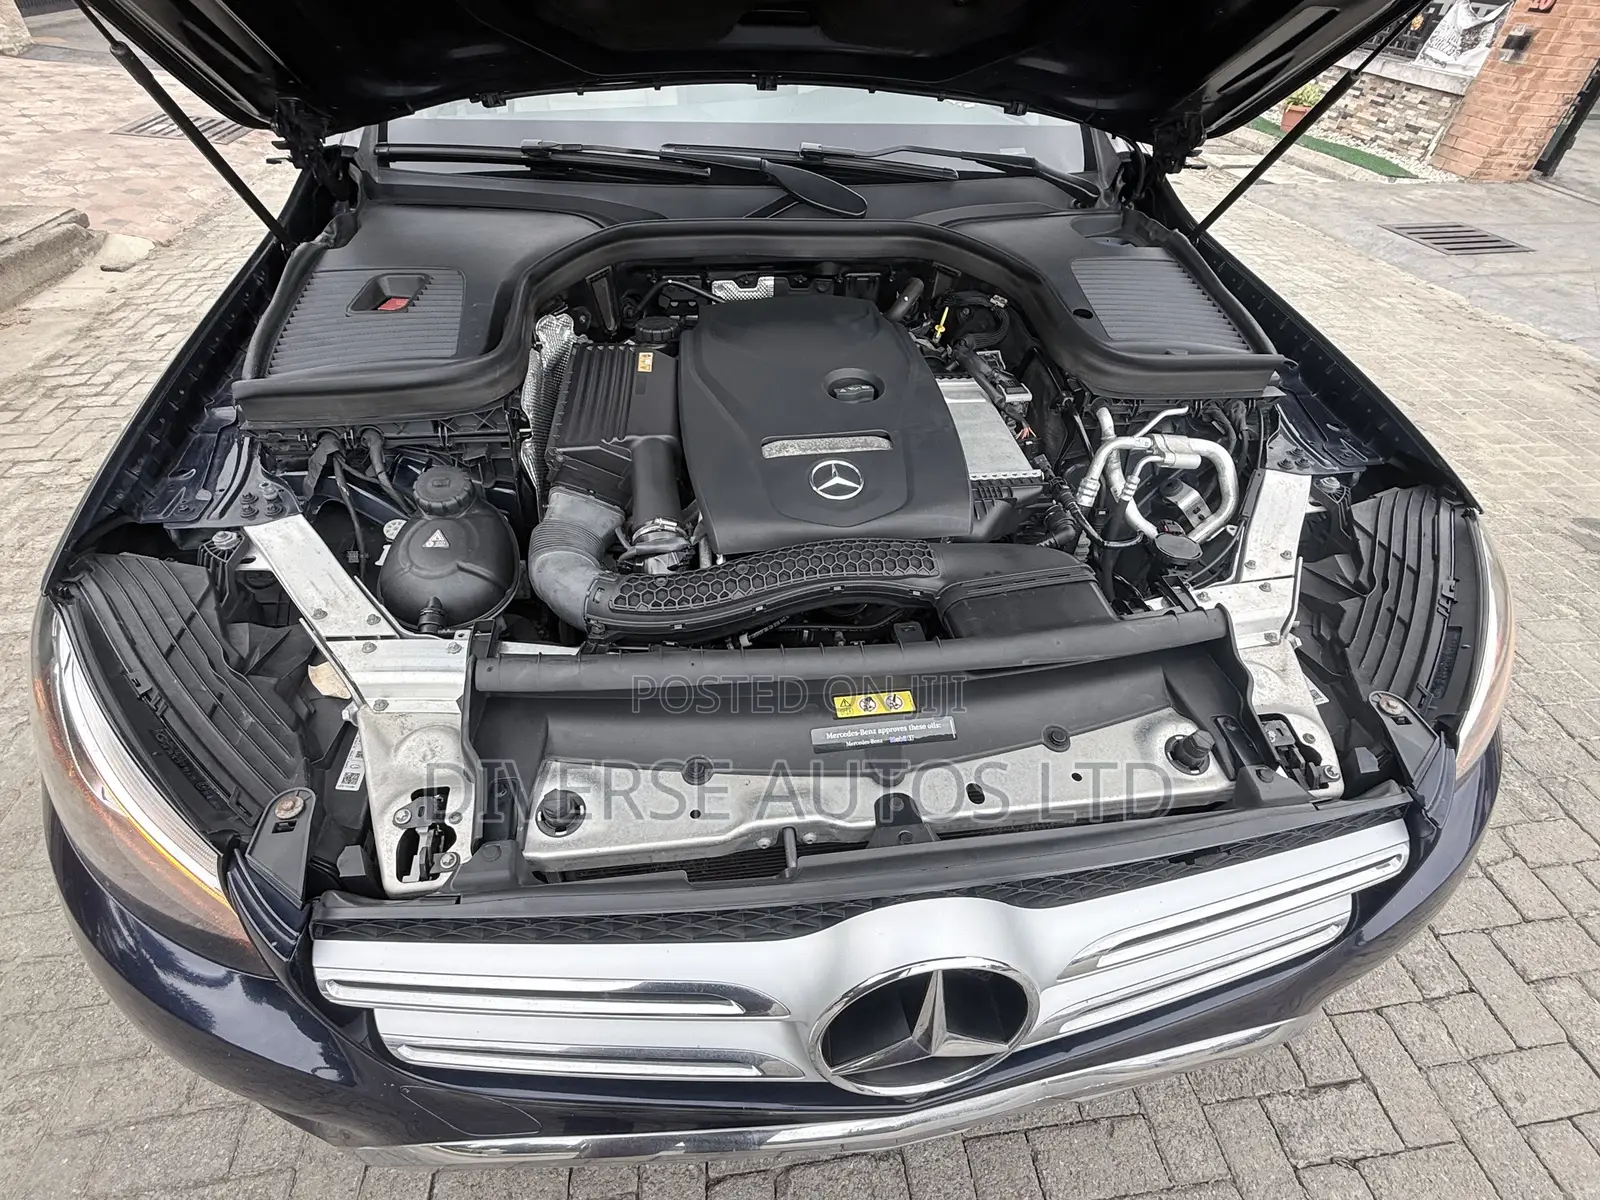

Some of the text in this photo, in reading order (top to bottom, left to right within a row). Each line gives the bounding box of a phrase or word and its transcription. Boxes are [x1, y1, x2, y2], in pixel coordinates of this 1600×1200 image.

[825, 728, 877, 740] Mercedes-Benz
[877, 725, 908, 735] approves
[908, 723, 927, 731] these
